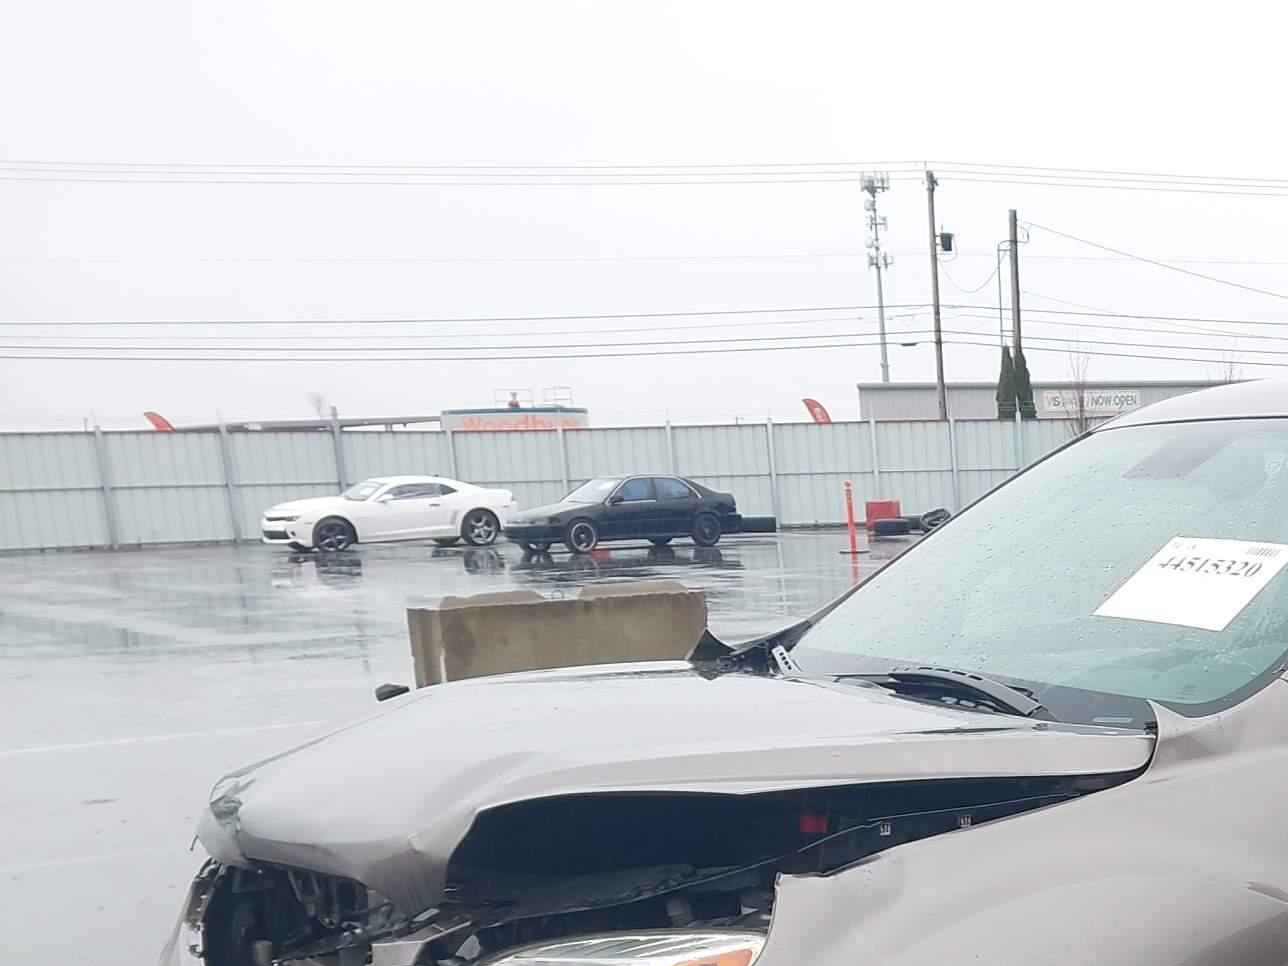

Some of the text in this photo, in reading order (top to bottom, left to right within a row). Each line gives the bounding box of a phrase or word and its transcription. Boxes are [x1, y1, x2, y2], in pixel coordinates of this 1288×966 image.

[1091, 395, 1113, 407] NOW
[1113, 394, 1137, 407] OPEN
[1158, 555, 1263, 578] 44515320
